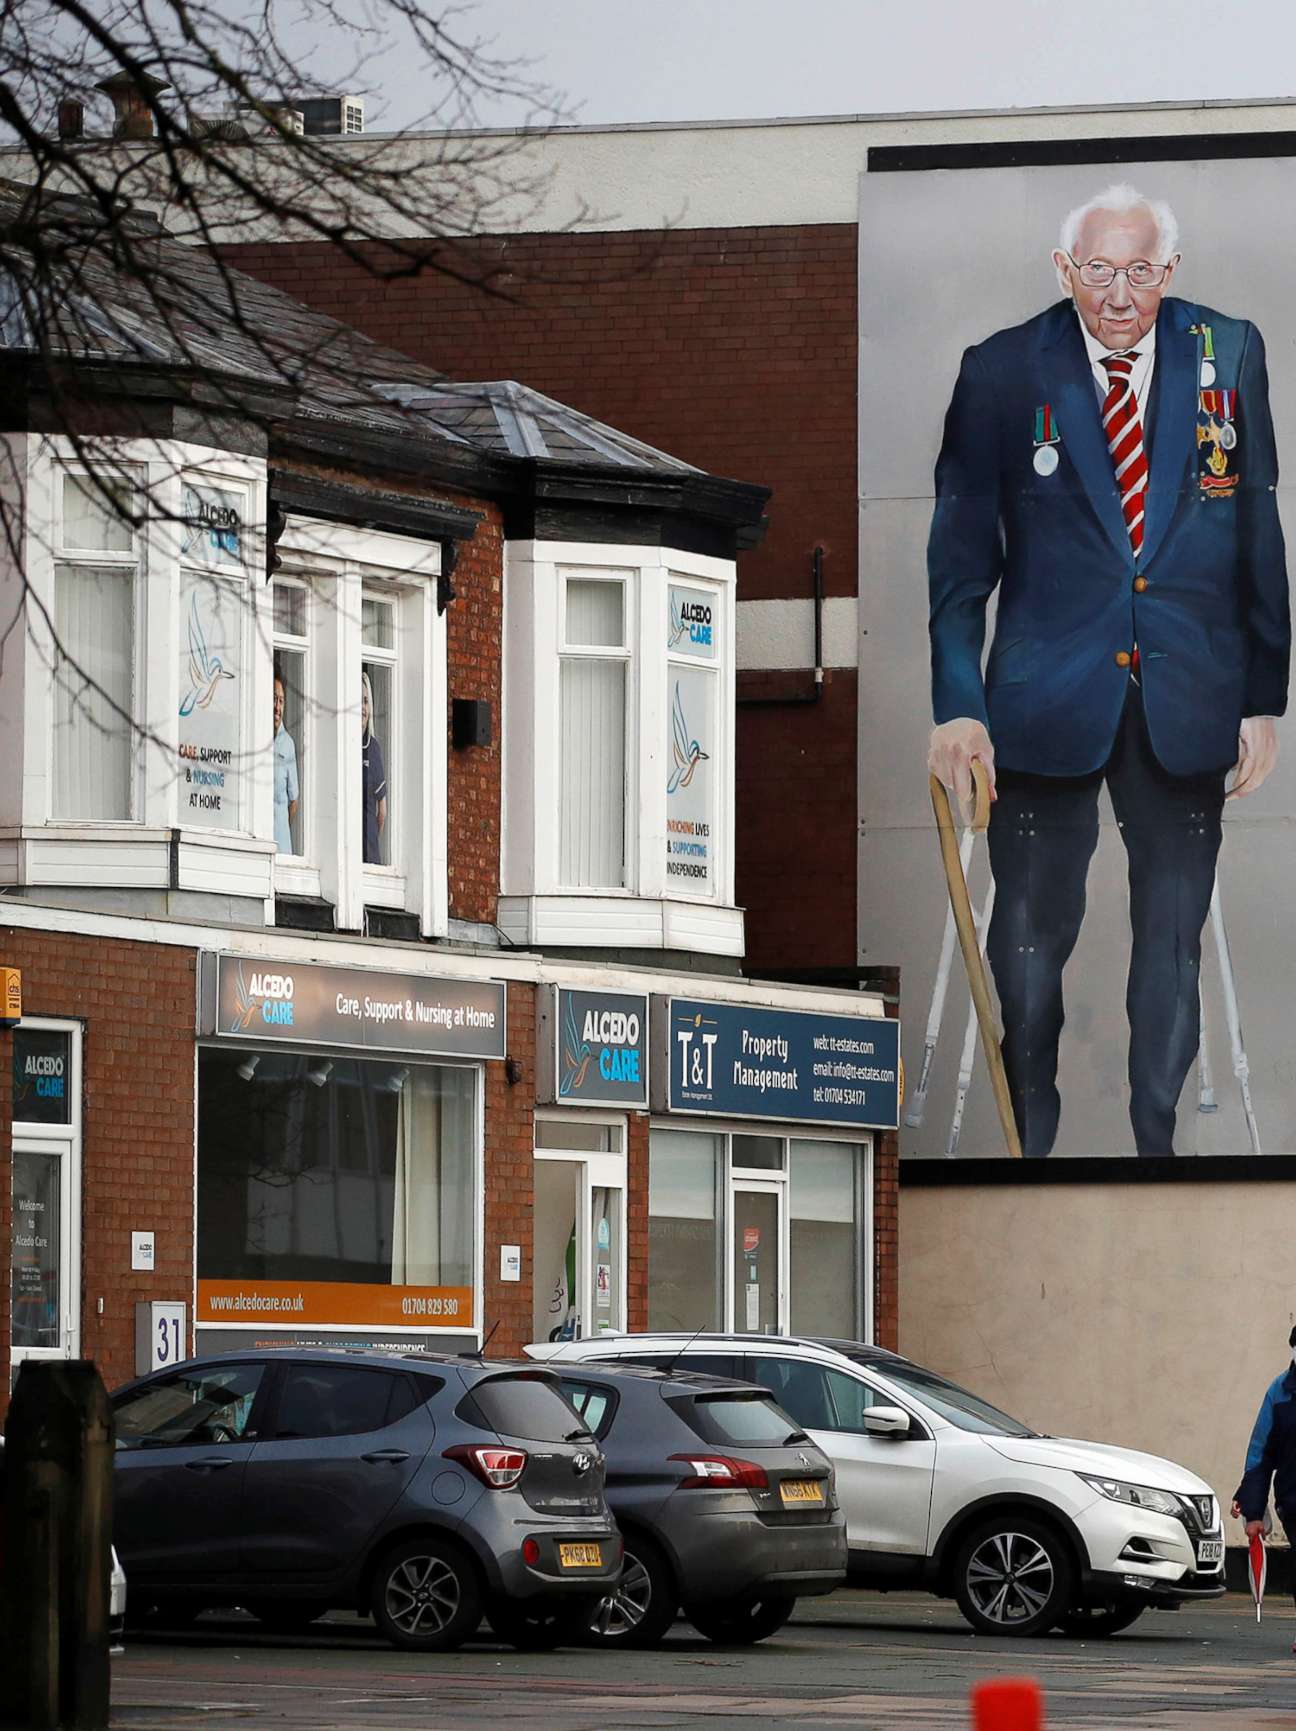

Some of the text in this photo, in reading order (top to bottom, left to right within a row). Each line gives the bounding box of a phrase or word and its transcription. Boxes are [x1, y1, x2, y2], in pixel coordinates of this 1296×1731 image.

[681, 602, 711, 625] ALCEDO
[690, 623, 712, 646] CARE
[200, 746, 232, 764] SUPPORT
[186, 767, 225, 788] & NURSING
[189, 793, 221, 810] AT HOME
[695, 821, 710, 837] LIVES
[672, 841, 707, 858] SUPPORTING
[249, 973, 294, 1000] ALCEDO
[262, 1000, 294, 1025] CARE
[336, 993, 495, 1030] Care, Support & Nursing at Home
[583, 1010, 640, 1046] ALCEDO
[742, 1029, 789, 1064] Property
[813, 1034, 875, 1055] web: tt-estates.com
[25, 1055, 65, 1076] ALCEDO
[600, 1047, 640, 1083] CARE
[677, 1031, 718, 1090] T&T
[733, 1060, 799, 1093] Management
[813, 1061, 832, 1078] email:
[833, 1061, 895, 1083] info@tt-estates.com
[36, 1078, 65, 1098] CARE
[813, 1086, 866, 1106] tel: 01704 534171
[19, 1199, 45, 1212] Welcome
[15, 1234, 48, 1248] Alcedo Care
[210, 1292, 458, 1316] www.alcedocare.co.uk 01704 829 580
[157, 1317, 179, 1362] 31
